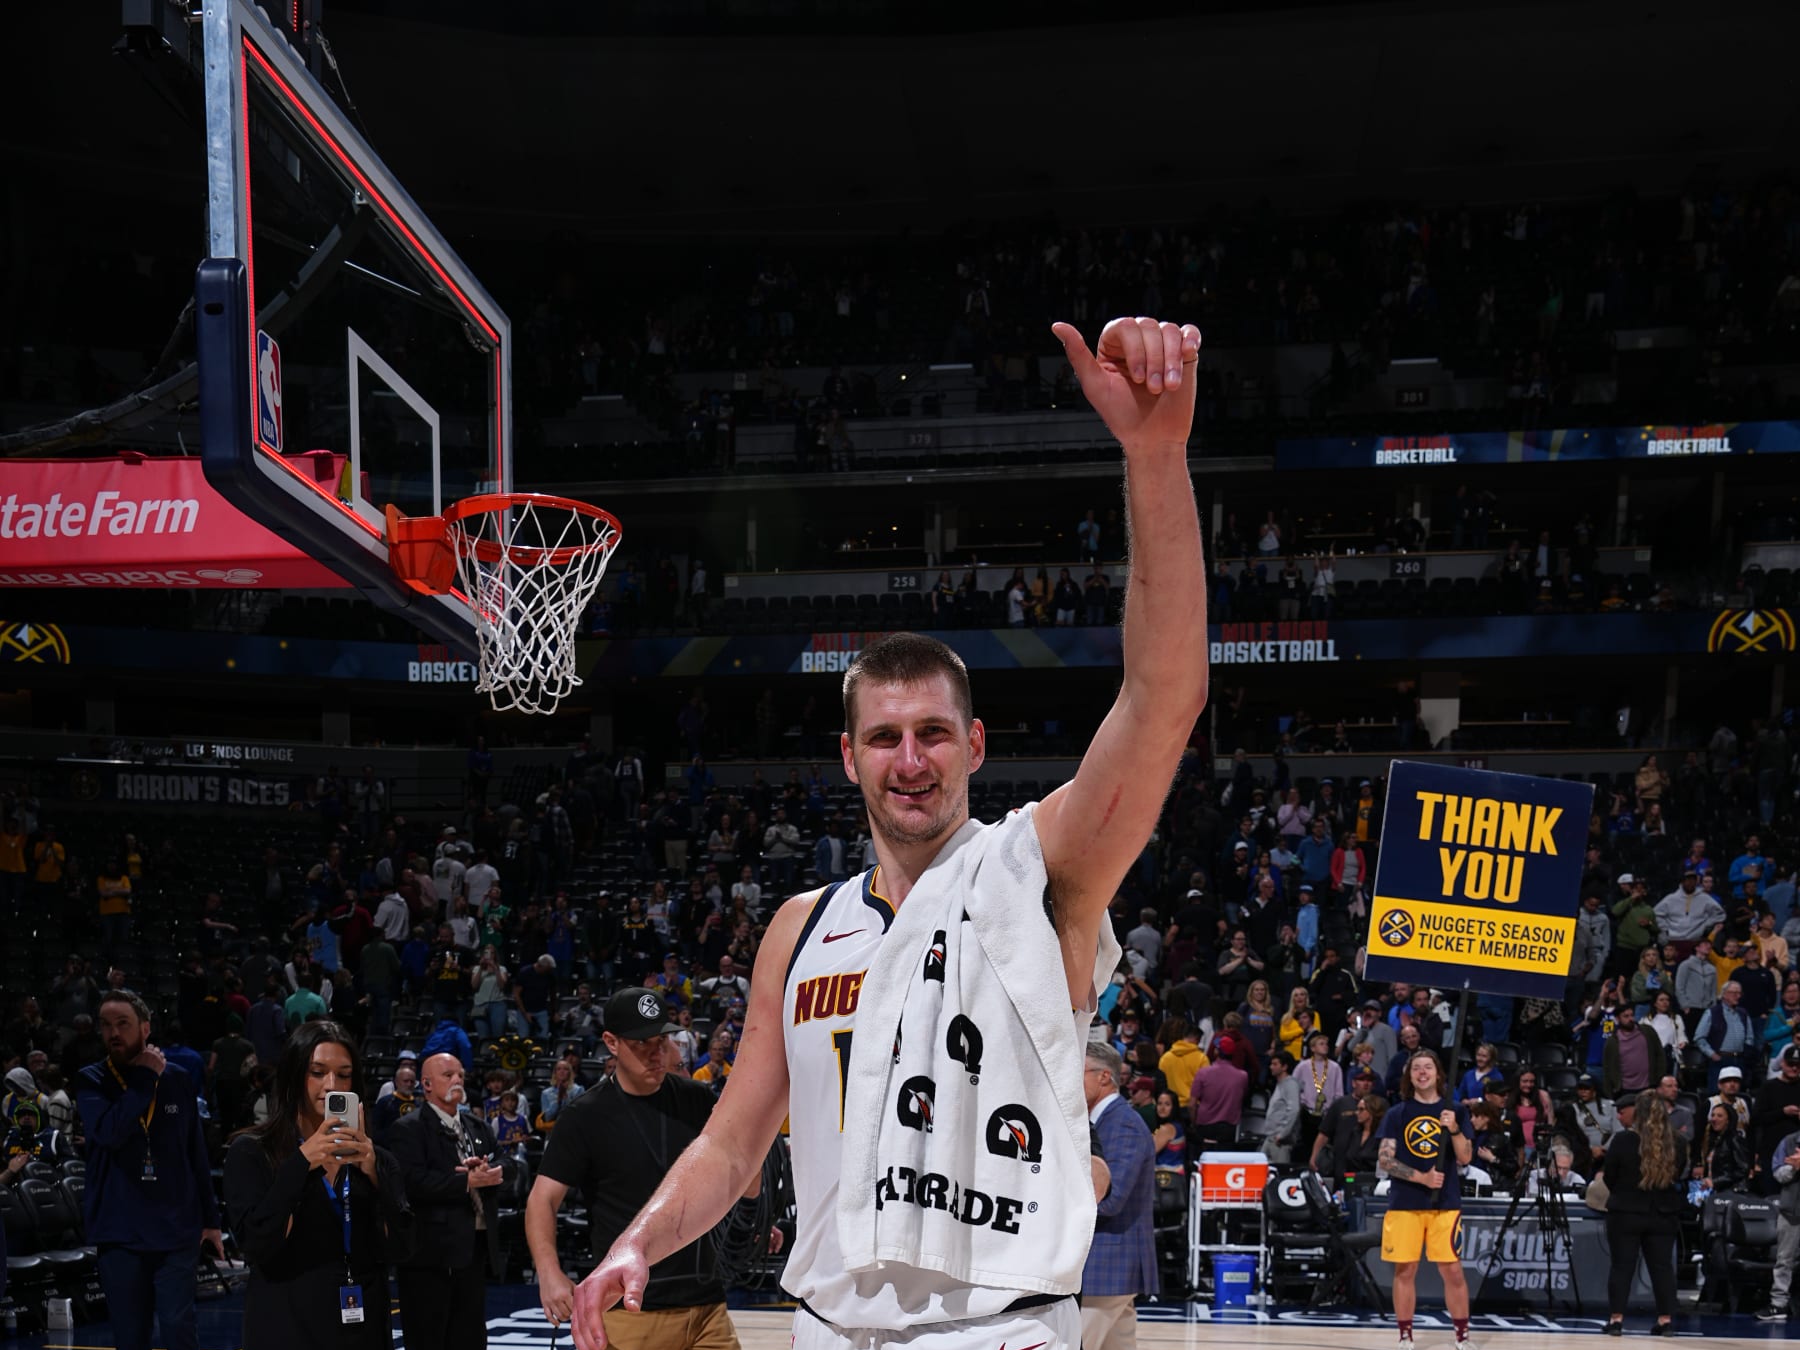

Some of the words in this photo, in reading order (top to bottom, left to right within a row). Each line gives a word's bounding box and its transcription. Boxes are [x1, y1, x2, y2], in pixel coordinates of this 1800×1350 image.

[1376, 448, 1457, 464] BASKETBALL
[1647, 437, 1733, 456] BASKETBALL
[1395, 562, 1421, 574] 260
[893, 576, 916, 588] 258
[1222, 622, 1273, 642] MILE
[1209, 639, 1340, 664] BASKETBALL
[186, 743, 242, 760] LEENDS
[244, 746, 295, 762] LOUNGE
[116, 773, 220, 802] AARON'S
[227, 777, 290, 806] ACES
[1416, 791, 1564, 856] THANK
[1439, 847, 1525, 904] YOU
[1419, 914, 1496, 937] NUGGETS
[1501, 923, 1565, 945] SEASON
[1418, 932, 1476, 953] TICKET
[1479, 939, 1558, 963] MEMBERS
[1225, 1167, 1246, 1190] G
[1278, 1178, 1307, 1207] G
[1503, 1271, 1569, 1291] sports
